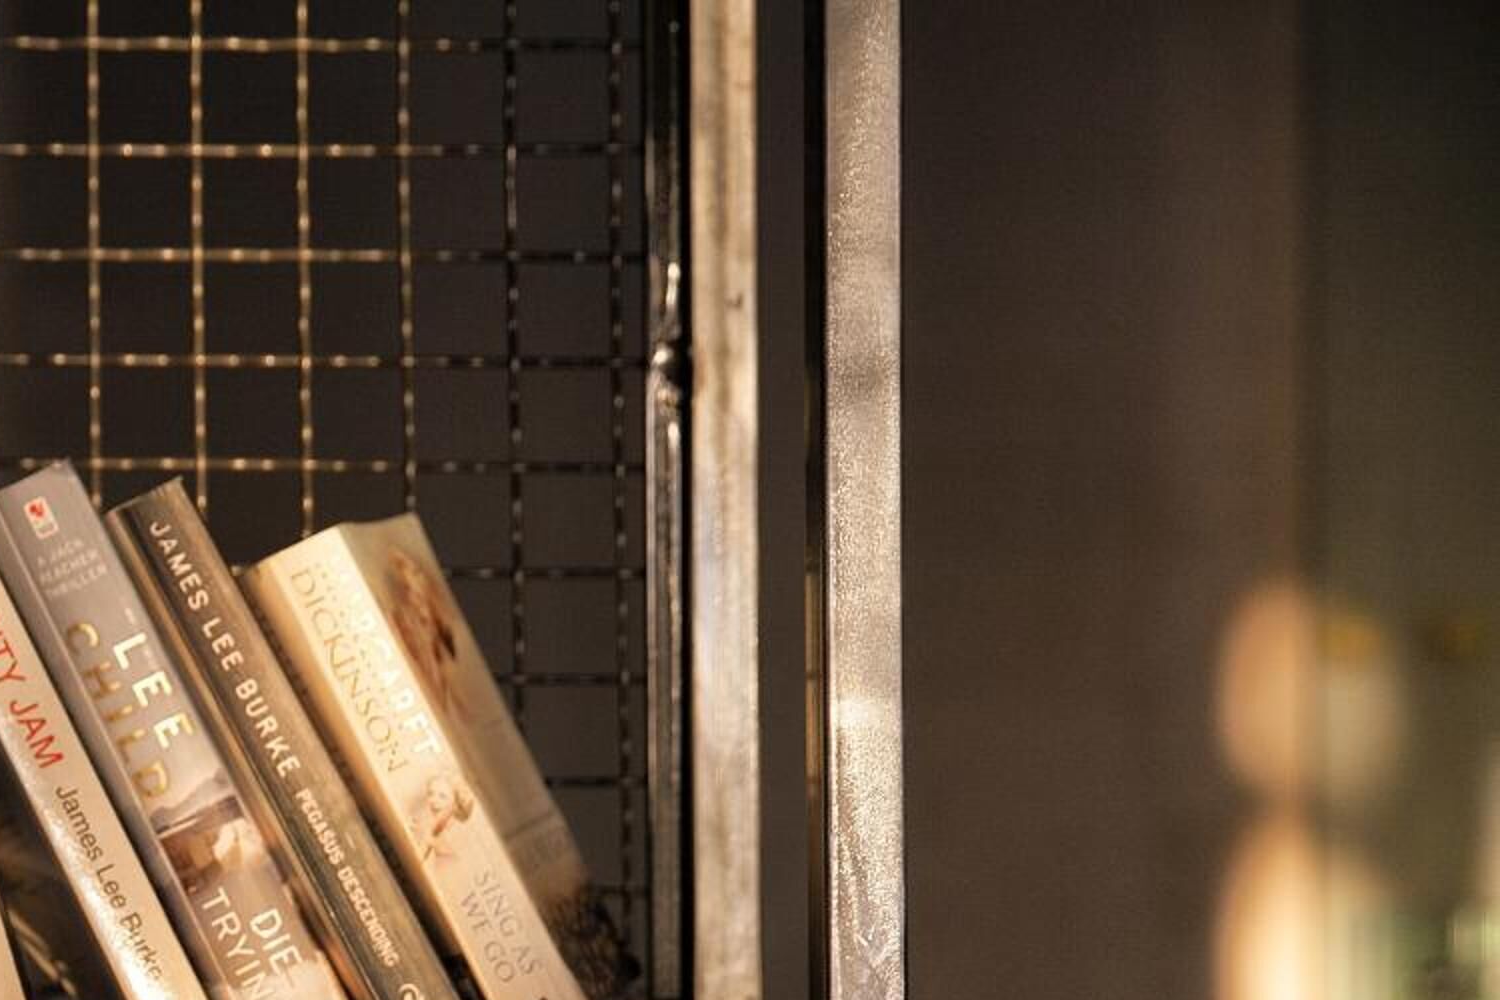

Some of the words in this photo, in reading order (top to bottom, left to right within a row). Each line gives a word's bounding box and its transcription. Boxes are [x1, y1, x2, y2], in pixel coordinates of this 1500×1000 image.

[9, 699, 65, 769] JAM
[67, 623, 169, 798] CHILD
[113, 632, 195, 749] LEE
[150, 521, 209, 612] JAMES
[202, 616, 244, 671] LEE
[235, 678, 302, 779] BURKE
[291, 569, 409, 772] DICKINSON
[312, 549, 443, 752] RGARET
[55, 785, 104, 862] James
[96, 863, 127, 909] Lee
[120, 911, 163, 980] Burke
[250, 908, 303, 976] DIE
[296, 787, 345, 865] PEGASUS
[337, 865, 400, 968] DESCENDING
[473, 869, 519, 937] SING
[484, 940, 516, 983] GO
